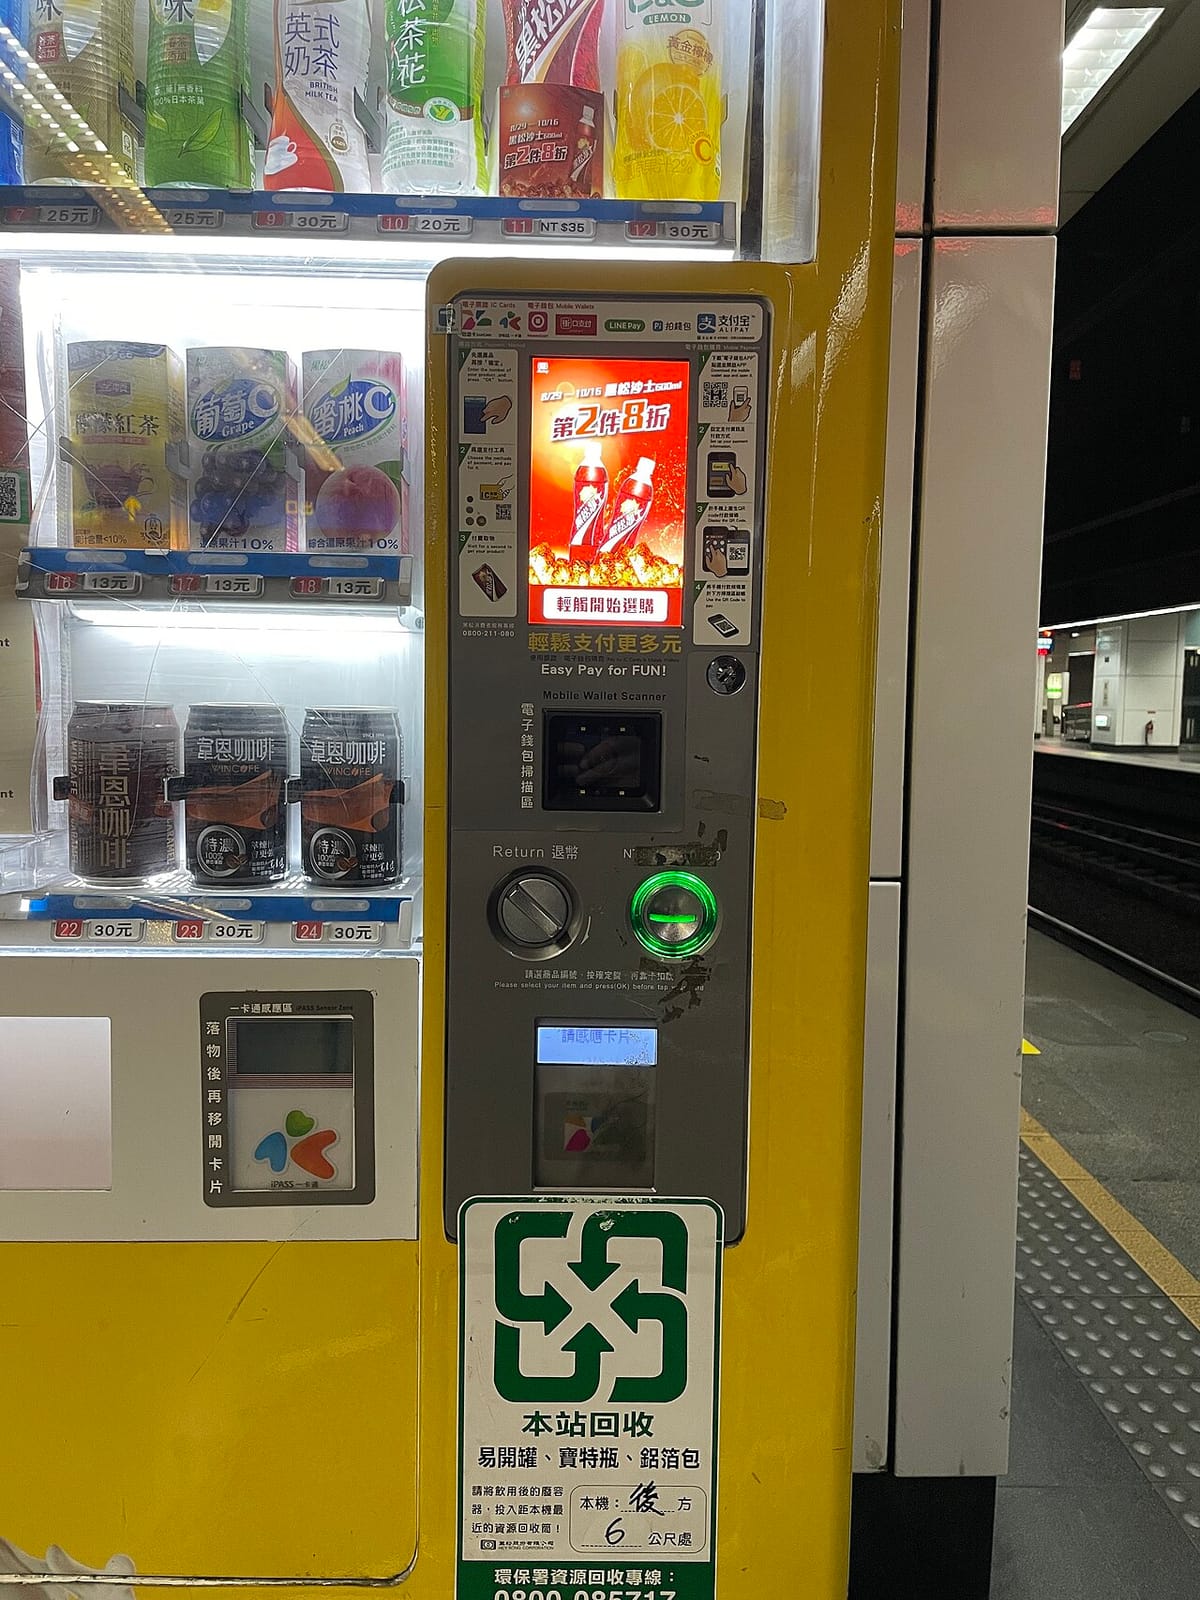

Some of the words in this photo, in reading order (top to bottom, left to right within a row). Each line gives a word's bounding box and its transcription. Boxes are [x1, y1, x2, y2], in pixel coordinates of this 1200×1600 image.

[648, 14, 686, 24] LEMON
[285, 12, 340, 48] 英式
[285, 45, 339, 80] 奶茶
[309, 82, 338, 93] BRITISH
[325, 93, 338, 102] TEA
[47, 208, 89, 223] 25元
[173, 212, 215, 226] 25元
[265, 213, 276, 225] 9
[297, 216, 337, 229] 30元
[387, 216, 404, 230] 10
[421, 218, 461, 231] 20元
[511, 220, 528, 233] 11
[634, 223, 651, 236] 12
[669, 226, 709, 238] 30元
[609, 320, 627, 329] LINE
[552, 399, 671, 441] 第2件8折
[222, 420, 255, 437] Grape
[343, 423, 364, 437] Peach
[91, 576, 128, 590] 13元
[177, 577, 195, 591] 17
[214, 578, 250, 592] 13元
[299, 579, 317, 593] 18
[335, 581, 372, 594] 13元
[556, 596, 654, 614] 輕觸開始選購
[528, 632, 682, 654] 輕鬆支付更多元
[541, 663, 573, 676] Easy
[578, 664, 603, 677] Pay
[608, 664, 628, 676] for
[632, 665, 666, 676] FUN!
[543, 690, 580, 701] Mobile
[583, 691, 617, 701] Wallet
[621, 692, 667, 702] Scanner
[197, 737, 275, 762] 韋恩咖啡
[310, 740, 387, 765] 韋恩咖啡
[520, 702, 534, 809] 電子錢包掃描區
[98, 743, 132, 868] 韋恩咖啡
[493, 845, 544, 858] Return
[551, 845, 579, 861] 退幣
[60, 922, 79, 938] 22
[95, 923, 133, 938] 30元
[181, 925, 199, 940] 23
[216, 925, 254, 939] 30元
[301, 925, 319, 939] 24
[335, 927, 373, 941] 30元
[544, 983, 560, 991] your
[657, 985, 669, 993] tap
[230, 1003, 293, 1013] 一卡通感應區
[206, 1021, 223, 1194] 落物後再移開卡片
[271, 1180, 294, 1188] iPASS
[521, 1411, 655, 1438] 本站回收
[478, 1447, 700, 1469] 易開罐、寶特瓶、鋁箔包
[471, 1485, 564, 1497] 請將飲用後的廢容
[628, 1480, 665, 1516] 後
[677, 1498, 692, 1511] 方
[604, 1517, 626, 1545] 6
[648, 1532, 692, 1547] 公尺處
